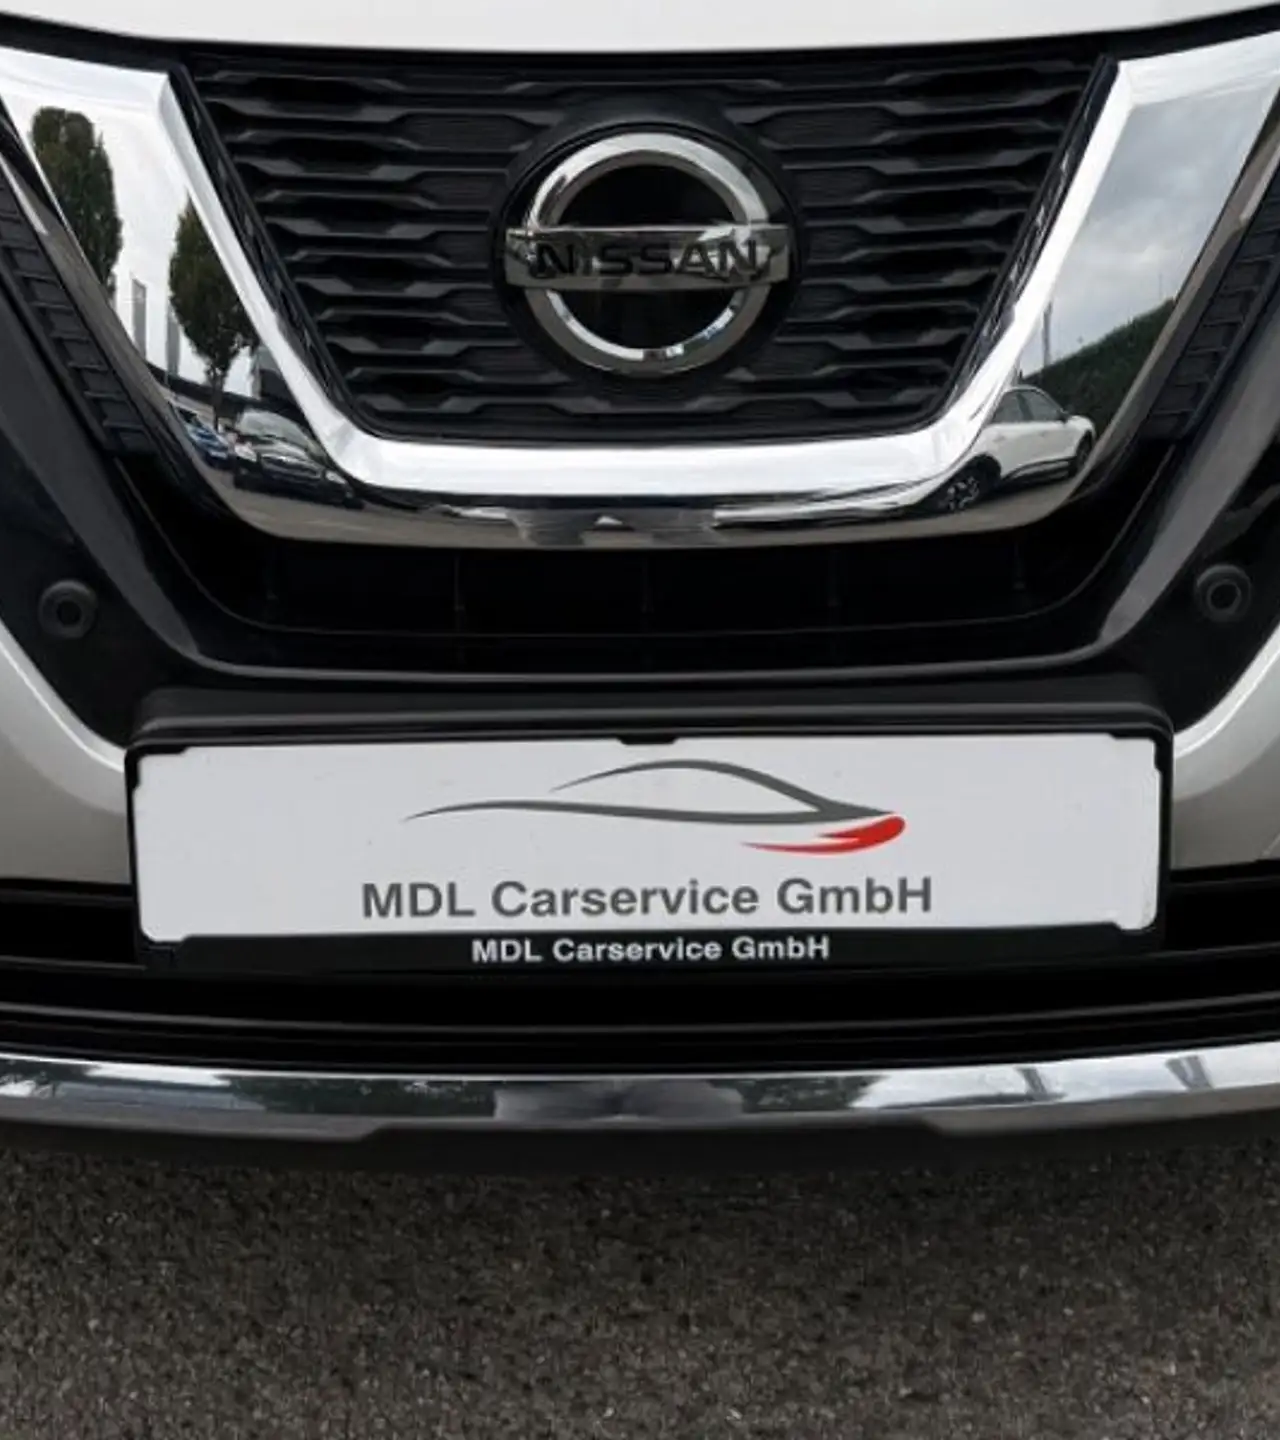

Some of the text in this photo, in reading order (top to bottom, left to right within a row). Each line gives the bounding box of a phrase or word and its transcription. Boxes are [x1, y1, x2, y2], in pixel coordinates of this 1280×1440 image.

[528, 239, 763, 281] NISSAN
[361, 876, 933, 919] MDL Carservice GmbH
[471, 935, 830, 963] MDL Carservice GmbH
